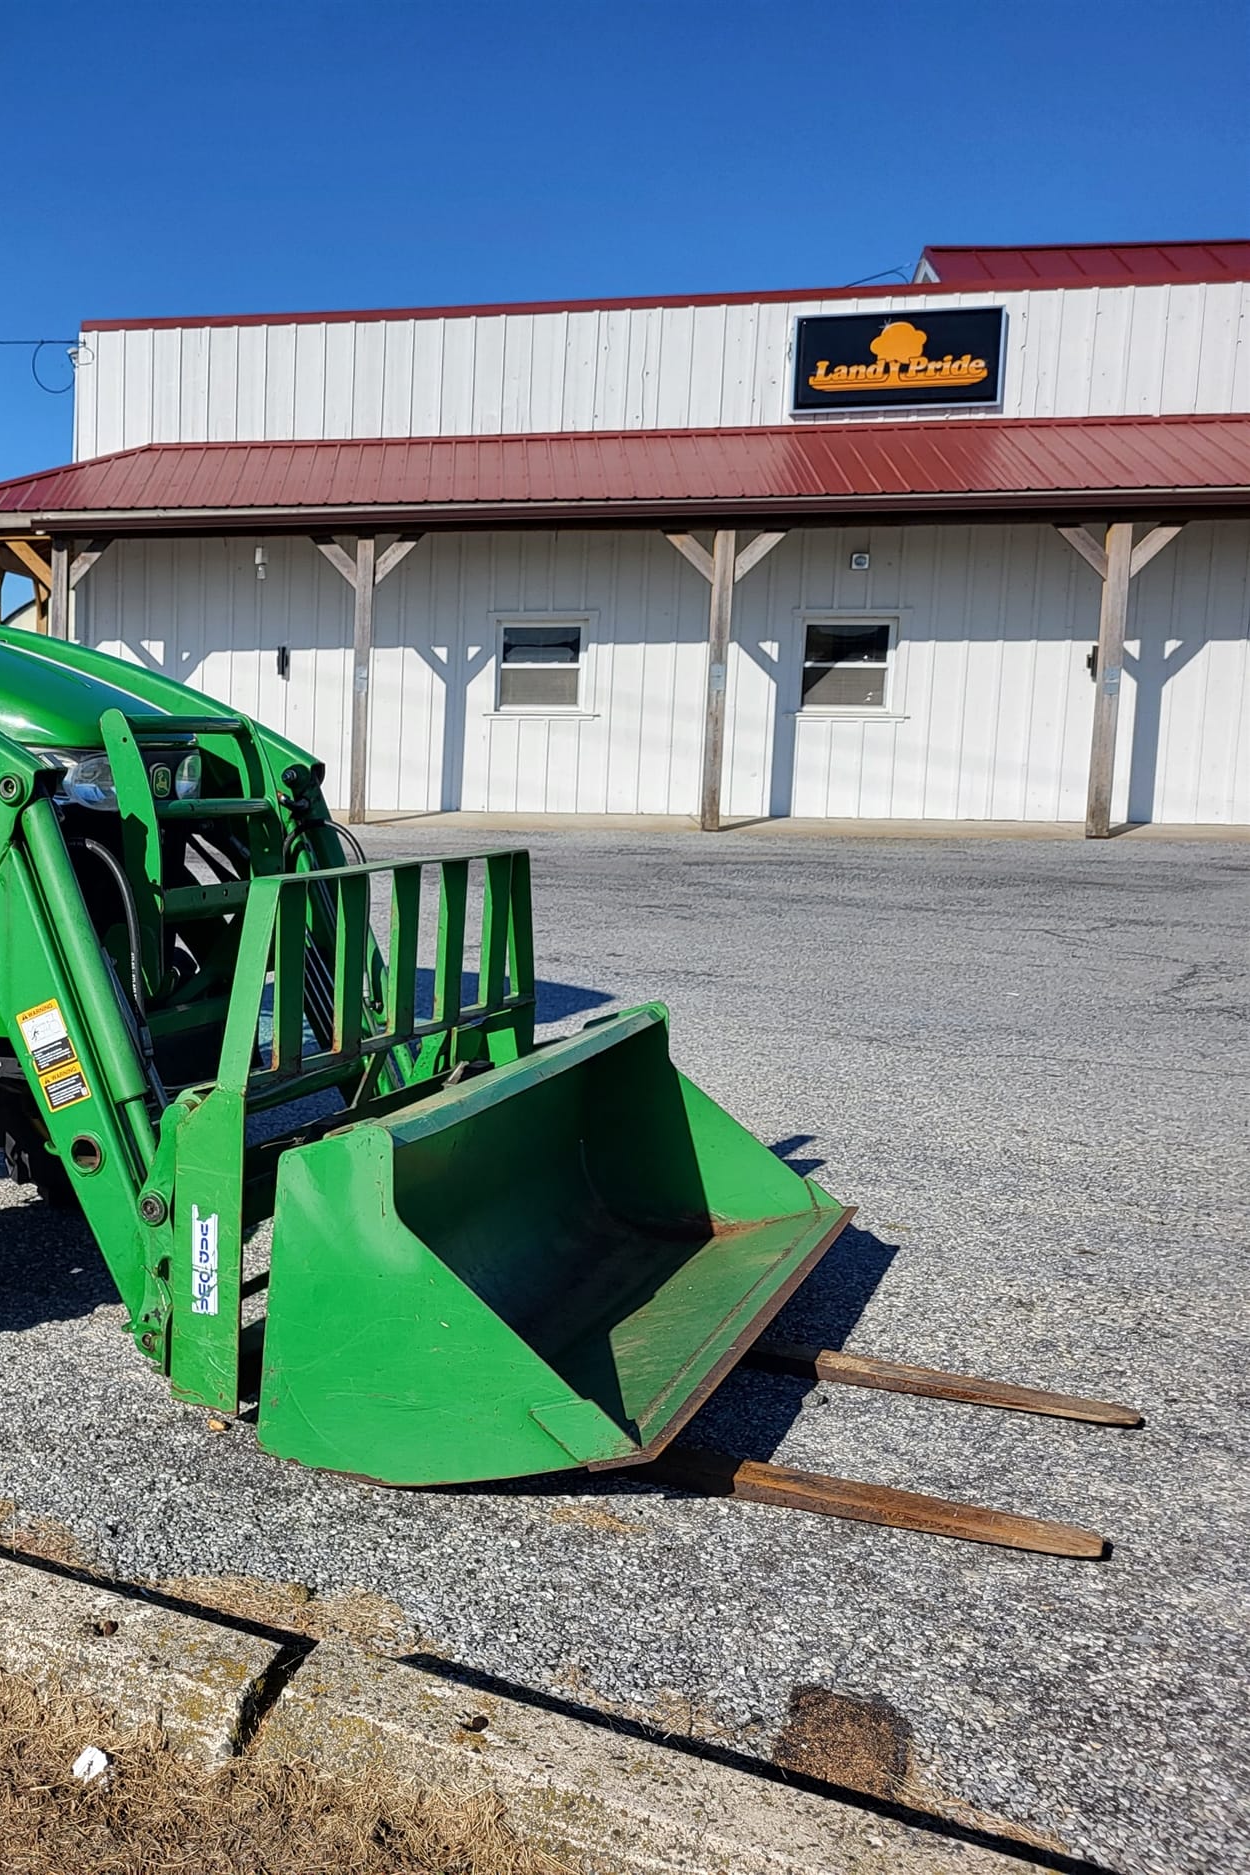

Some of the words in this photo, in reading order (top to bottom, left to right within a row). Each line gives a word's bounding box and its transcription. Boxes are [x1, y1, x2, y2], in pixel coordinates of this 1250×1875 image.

[812, 359, 886, 382] Land
[907, 354, 986, 378] Pride
[28, 1002, 54, 1018] WARNING
[51, 1065, 78, 1081] WARNING
